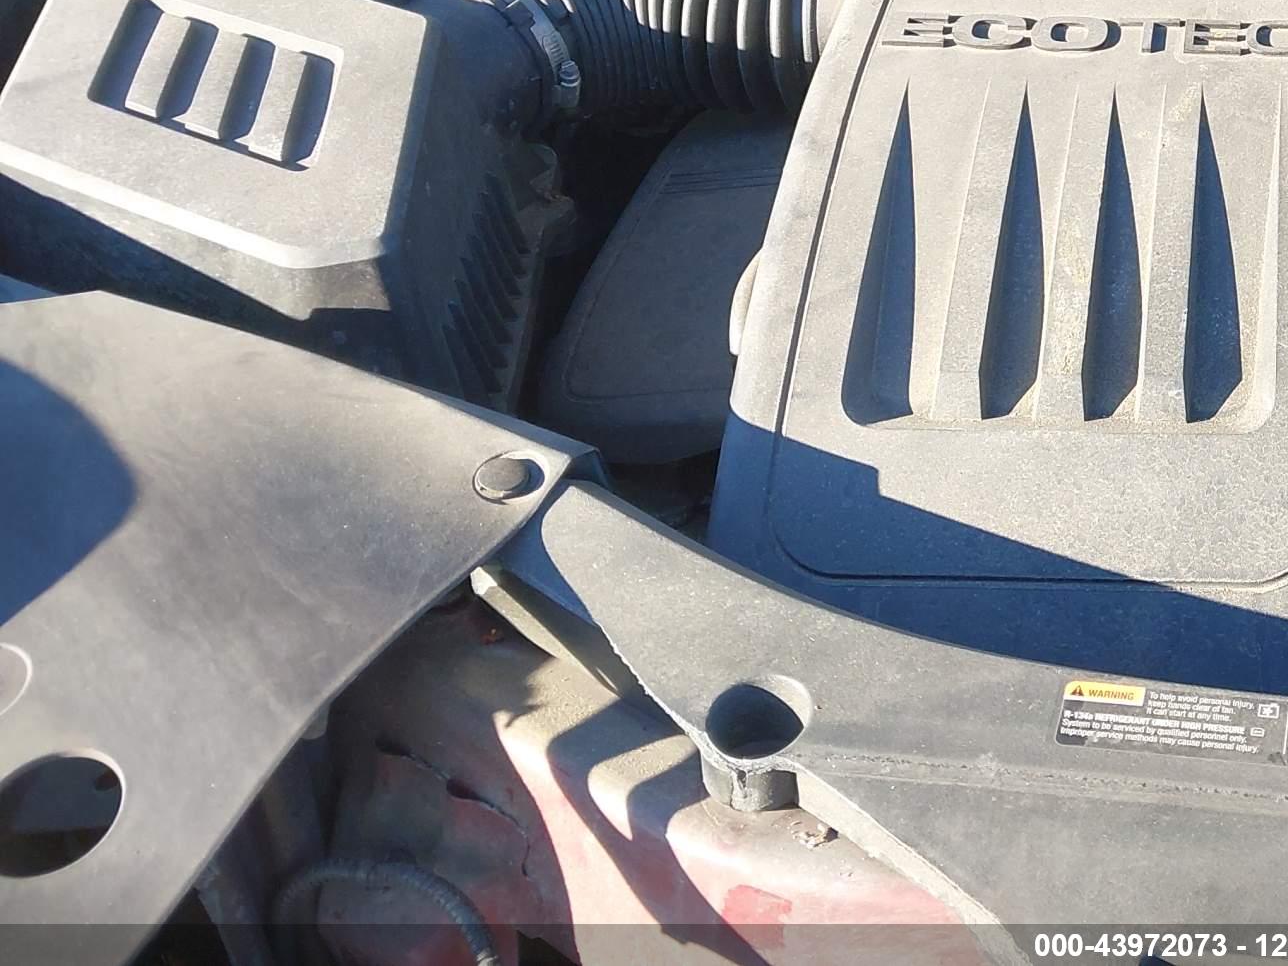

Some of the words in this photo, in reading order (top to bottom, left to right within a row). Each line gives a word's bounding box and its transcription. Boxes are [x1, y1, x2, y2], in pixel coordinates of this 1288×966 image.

[1089, 689, 1134, 700] WARNING
[1160, 693, 1176, 701] help
[1178, 695, 1197, 703] avoid
[1199, 697, 1230, 706] personal
[1168, 702, 1190, 710] hands
[1192, 704, 1211, 712] clear
[1095, 713, 1149, 725] REFRIGERANT
[1152, 718, 1179, 728] UNDER
[1181, 721, 1201, 730] HIGH
[1203, 723, 1245, 734] PRESSURE
[1197, 713, 1211, 721] any
[1213, 714, 1231, 722] time.
[1062, 719, 1090, 728] System
[1113, 724, 1144, 733] serviced
[1147, 726, 1155, 735] by
[1157, 728, 1189, 737] qualified
[1191, 732, 1228, 741] personnel
[1230, 735, 1247, 744] only.
[1060, 727, 1093, 737] Improper
[1096, 731, 1123, 739] service
[1125, 734, 1157, 742] methods
[1160, 738, 1177, 746] may
[1202, 741, 1234, 750] personal
